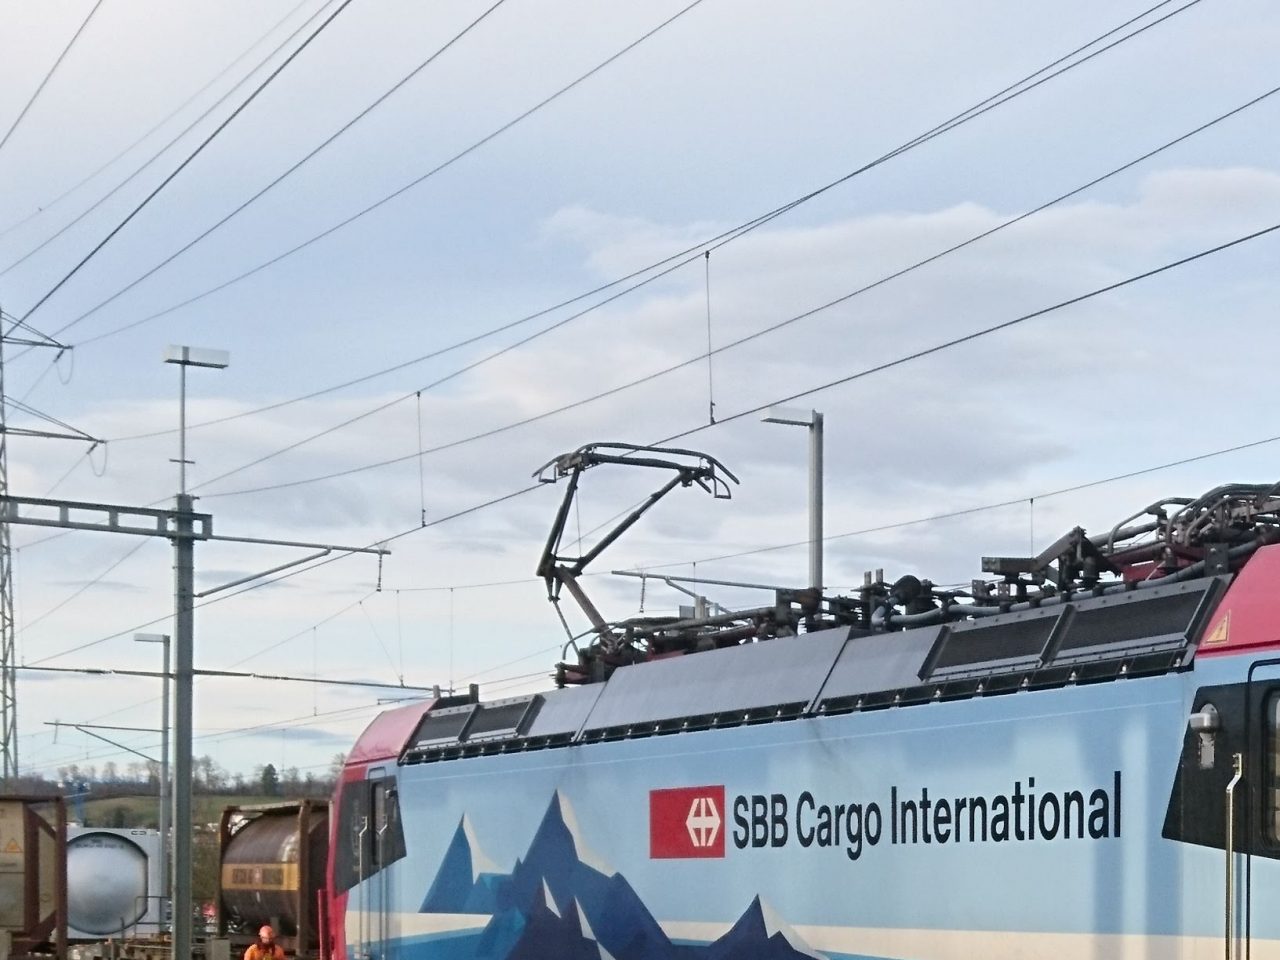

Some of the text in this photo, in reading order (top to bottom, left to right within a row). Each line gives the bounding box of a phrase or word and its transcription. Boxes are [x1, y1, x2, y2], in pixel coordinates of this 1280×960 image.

[732, 770, 1122, 860] SBB Cargo International
